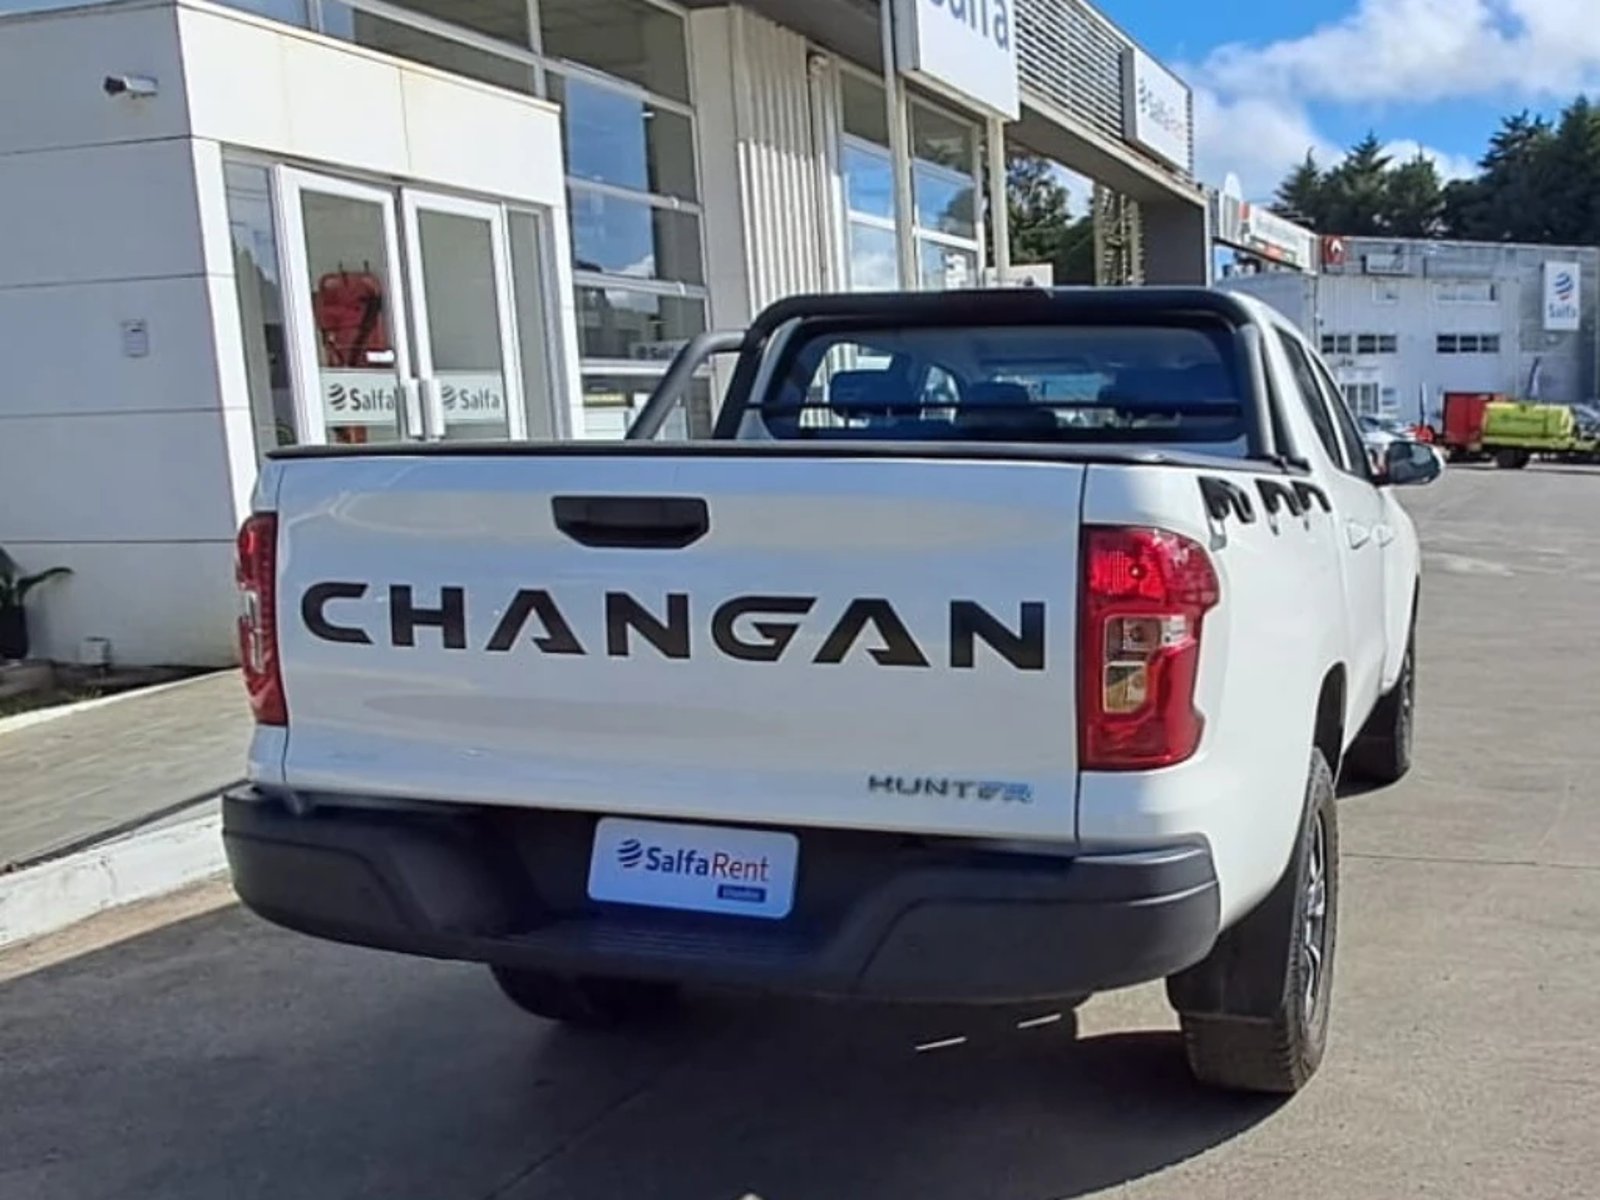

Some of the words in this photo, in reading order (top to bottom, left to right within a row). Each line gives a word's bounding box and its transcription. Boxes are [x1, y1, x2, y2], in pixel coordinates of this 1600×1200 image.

[350, 387, 396, 411] Salfa
[459, 388, 500, 411] Salfa
[301, 582, 1045, 671] CHANGAN
